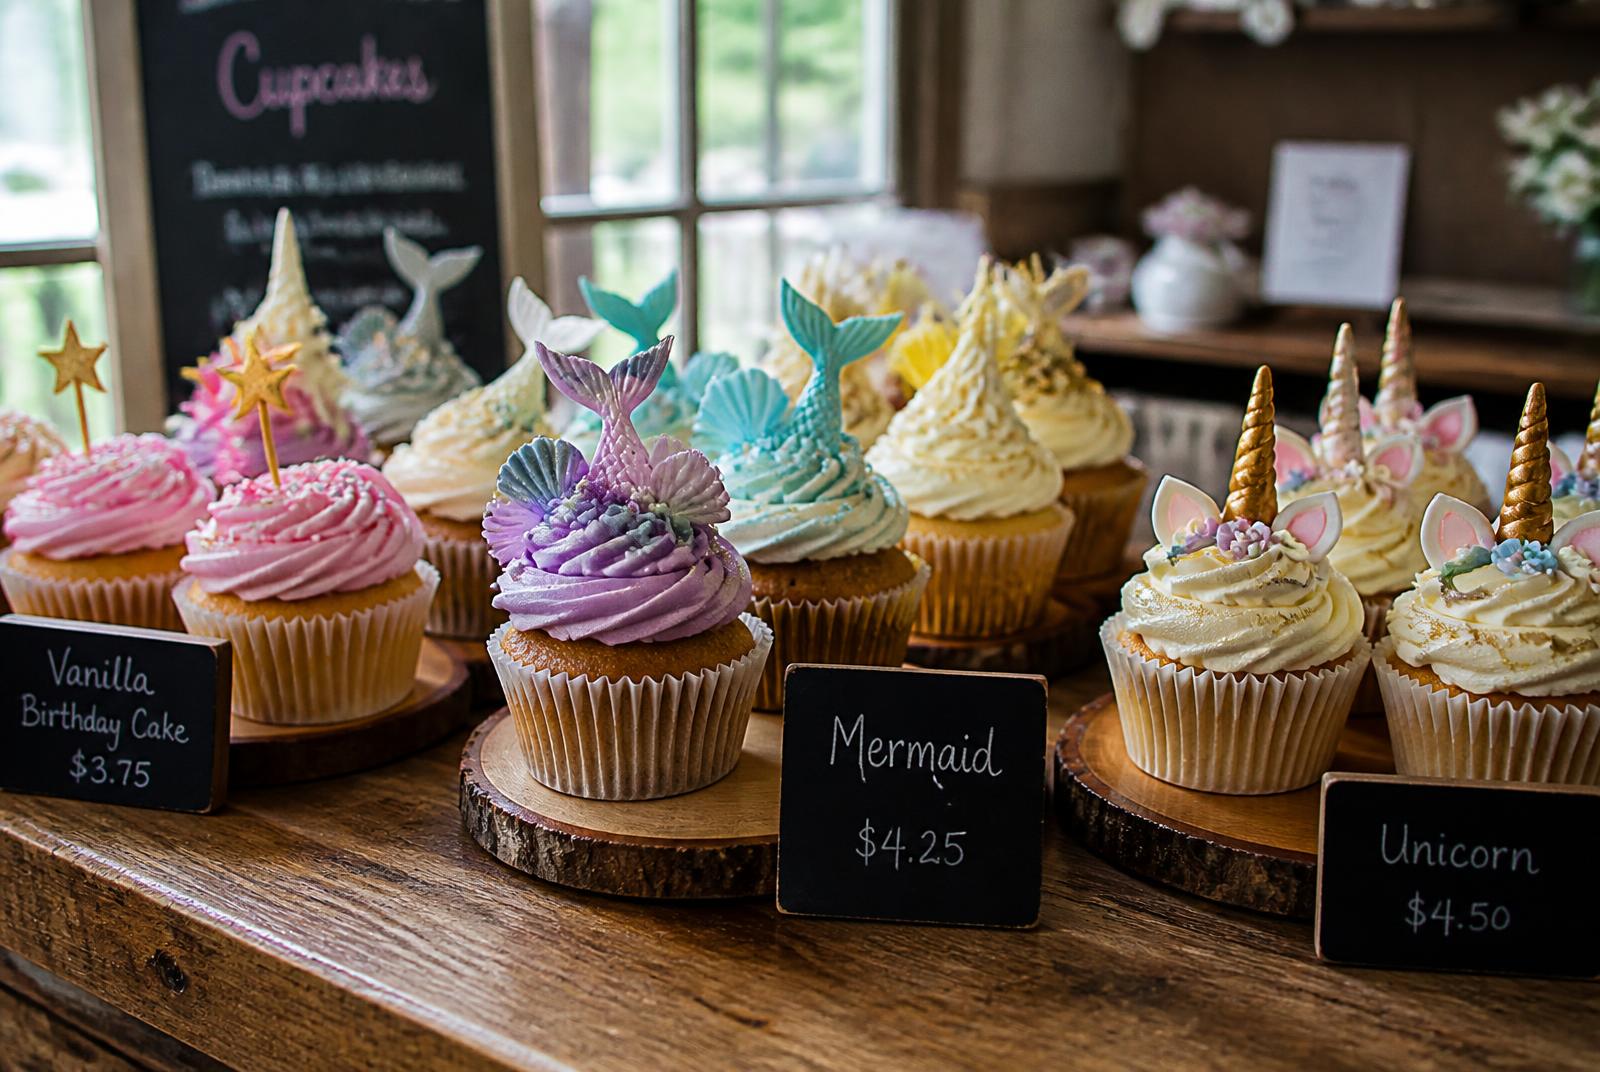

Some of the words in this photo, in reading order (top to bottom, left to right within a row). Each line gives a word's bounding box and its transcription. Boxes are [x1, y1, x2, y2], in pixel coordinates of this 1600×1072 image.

[216, 30, 436, 138] Cupcakes
[47, 646, 155, 695] Vanilla
[21, 692, 121, 752] Birthday
[131, 707, 190, 744] Cake
[830, 713, 1003, 783] Mermaid
[69, 748, 152, 788] $3.75
[855, 817, 967, 871] $4.25
[1381, 823, 1540, 875] Unicorn
[1404, 890, 1511, 937] $4.50
